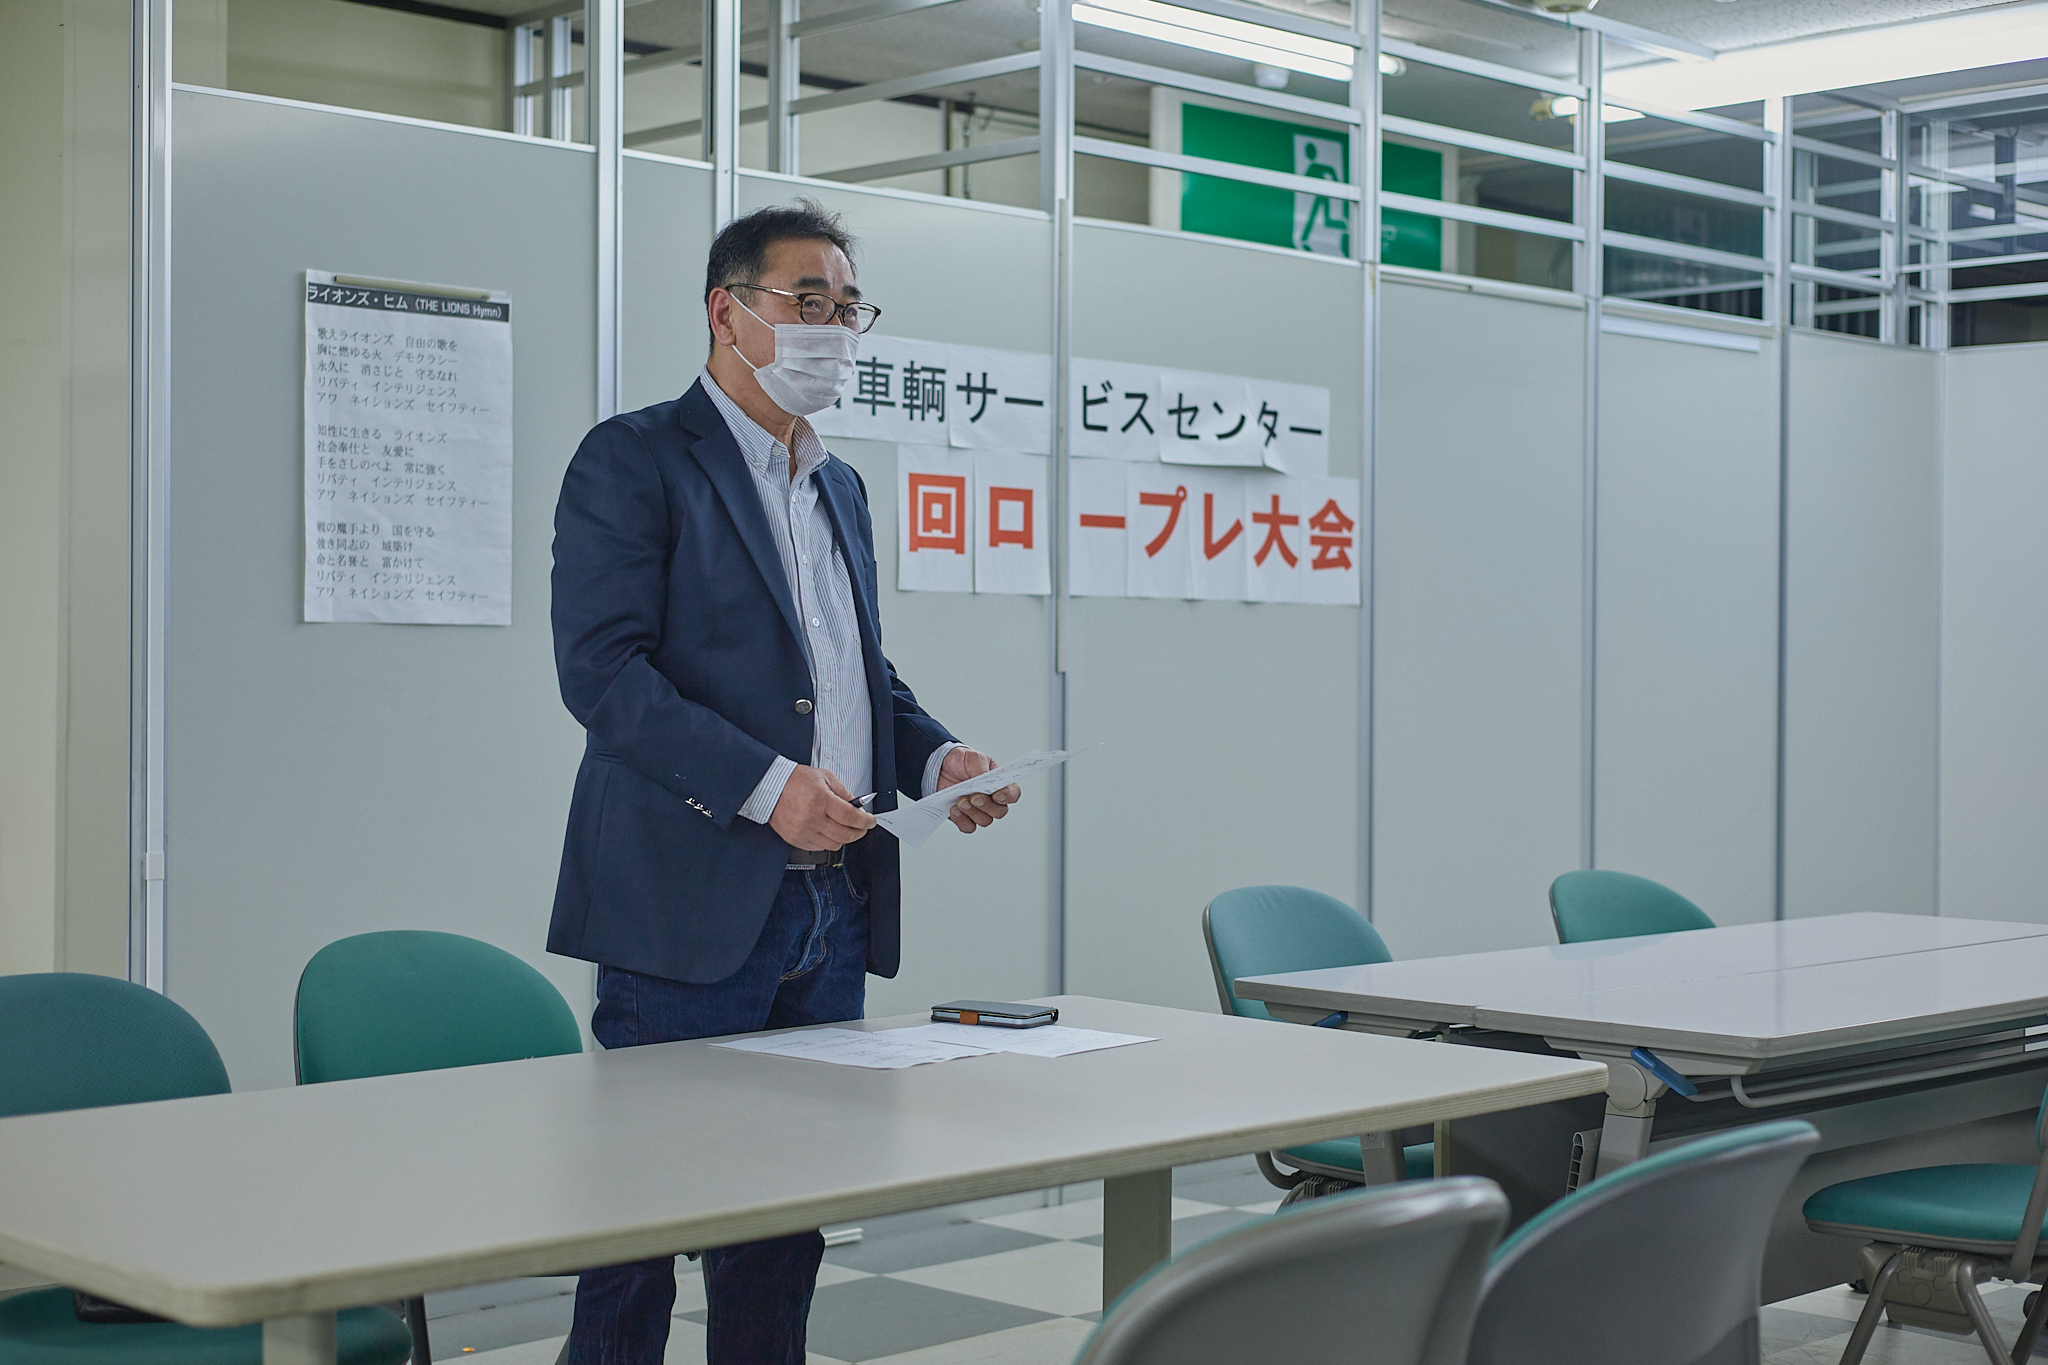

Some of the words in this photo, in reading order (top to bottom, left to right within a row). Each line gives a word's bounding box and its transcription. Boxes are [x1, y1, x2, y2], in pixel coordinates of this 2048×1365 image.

[308, 286, 408, 310] ライオンズ・ヒム
[442, 301, 470, 315] LIONS
[317, 328, 394, 346] 歌えライオンズ
[405, 336, 458, 351] 自由の歌を
[317, 344, 382, 360] 胸に燃ゆる火
[394, 351, 458, 365] デモクラシー
[317, 360, 349, 373] 永久に
[361, 364, 404, 378] 消さじと
[415, 368, 458, 382] 守るなれ
[372, 381, 457, 398] インテリジェンス
[317, 392, 338, 404] アワ
[351, 395, 415, 411] ネイションズ
[426, 400, 490, 415] セイフティー
[835, 356, 1323, 447] 車輌サービスセンター
[317, 424, 382, 440] 知性に生きる
[394, 430, 448, 444] ライオンズ
[317, 440, 370, 455] 社会奉仕と
[382, 445, 414, 458] 友愛に
[404, 462, 446, 476] 常に強く
[372, 477, 457, 492] インテリジェンス
[317, 489, 337, 500] アワ
[349, 492, 414, 505] ネイションズ
[425, 495, 490, 508] セイフティー
[316, 522, 380, 535] 戦の魔手より
[392, 525, 435, 538] 国を守る
[316, 538, 370, 551] 強き同志の
[382, 541, 413, 553] 城築け
[316, 554, 369, 568] 命と名誉と
[382, 557, 425, 569] 富かけて
[371, 572, 456, 585] インテリジェンス
[316, 587, 336, 598] アワ
[348, 588, 414, 600] ネイションズ
[425, 590, 489, 602] セイフティー
